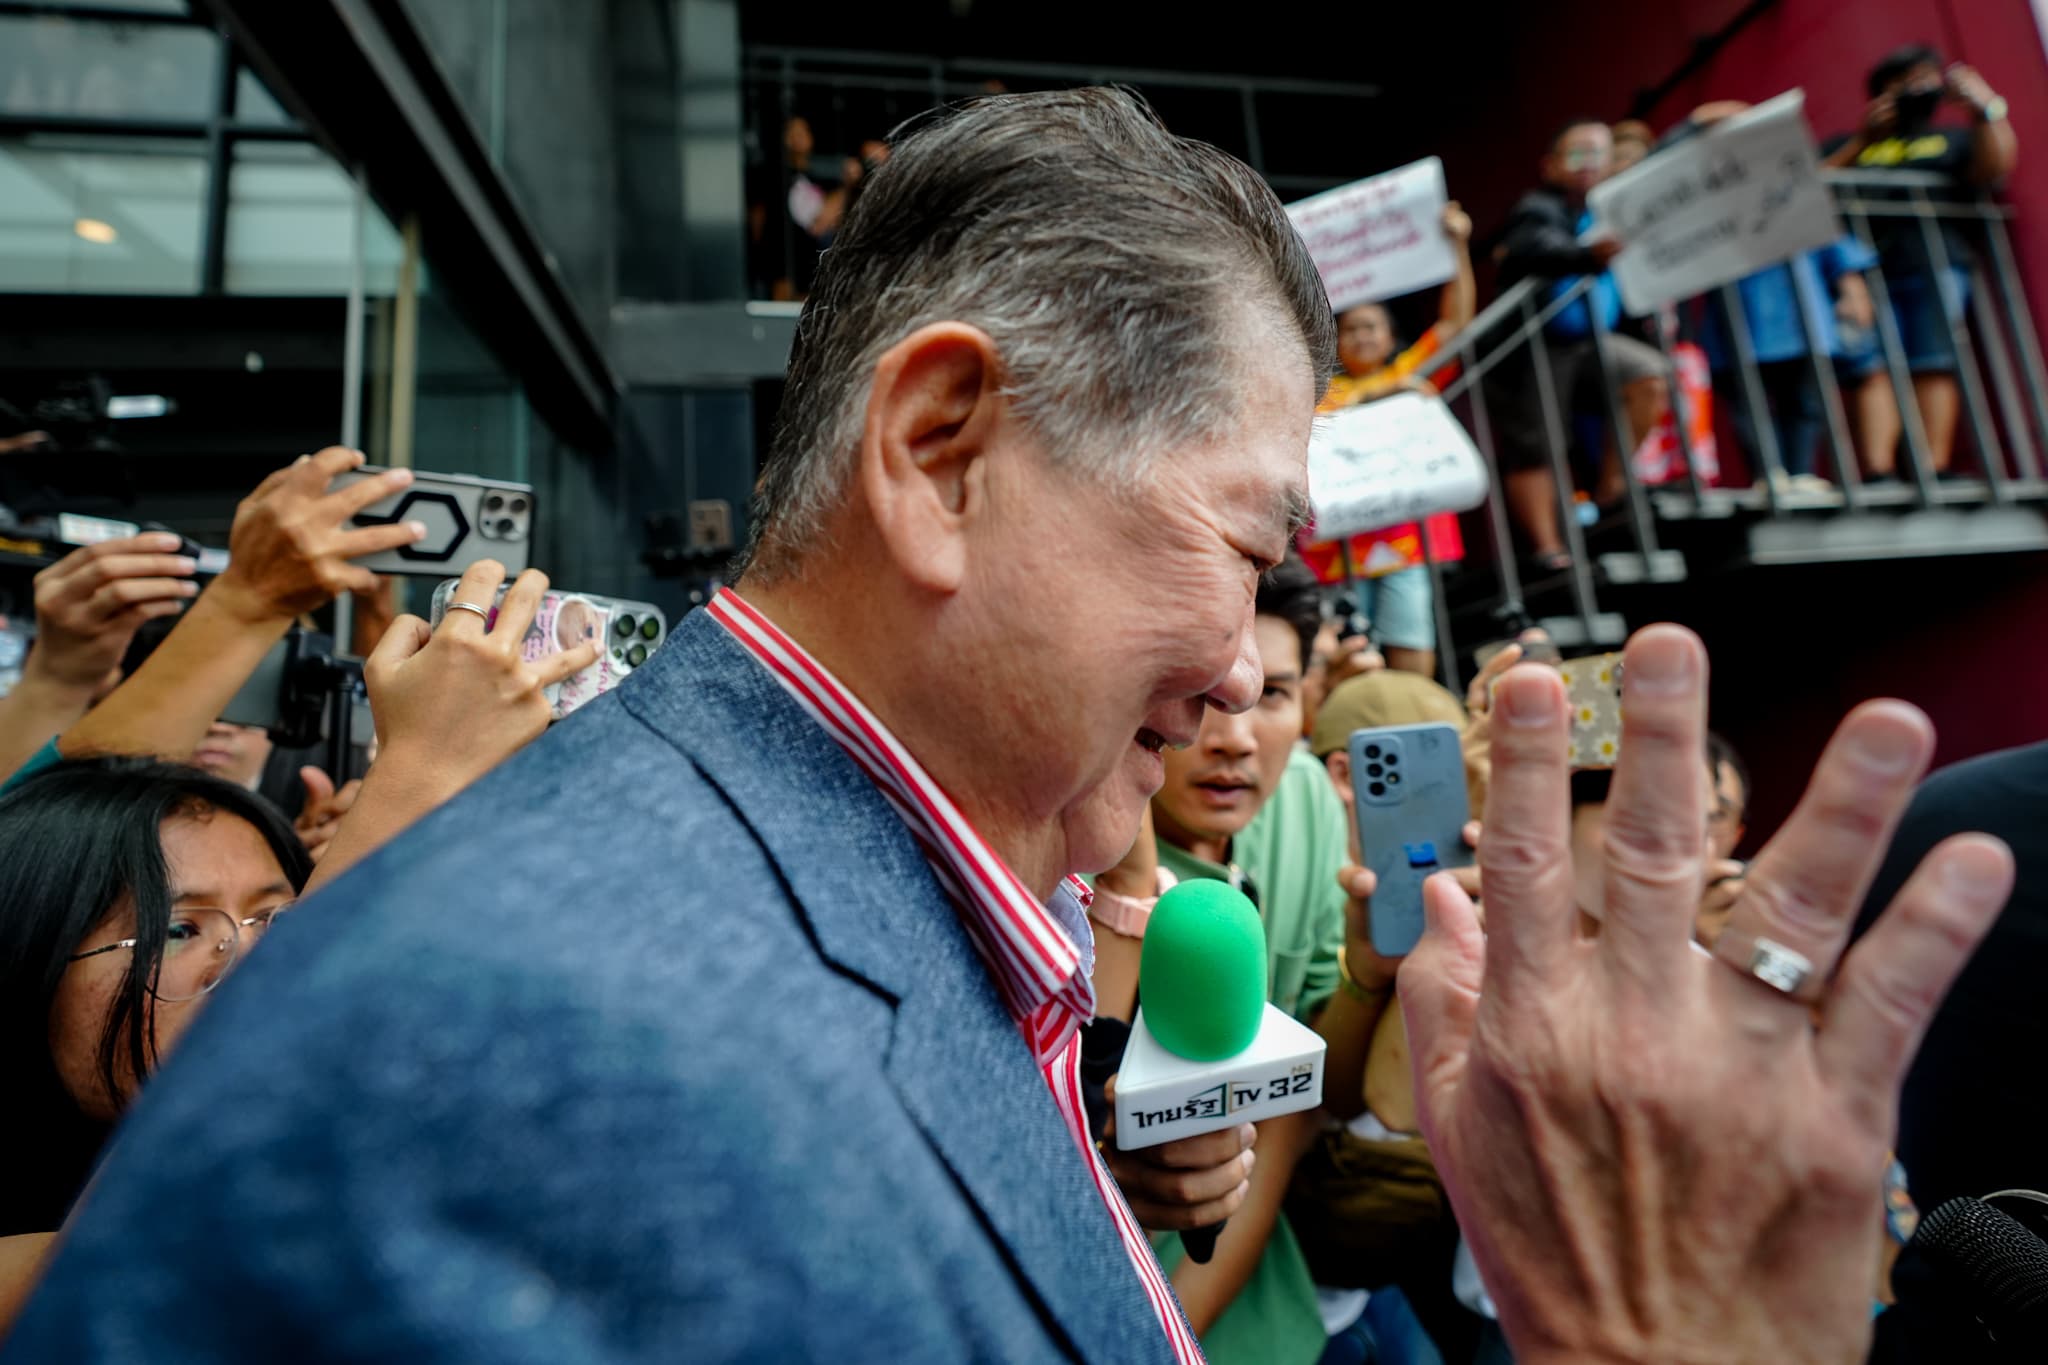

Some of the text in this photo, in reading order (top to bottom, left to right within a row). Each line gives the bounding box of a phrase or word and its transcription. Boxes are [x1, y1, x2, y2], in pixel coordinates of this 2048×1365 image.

[1131, 1073, 1312, 1128] ไทยรัฐ TV 32
